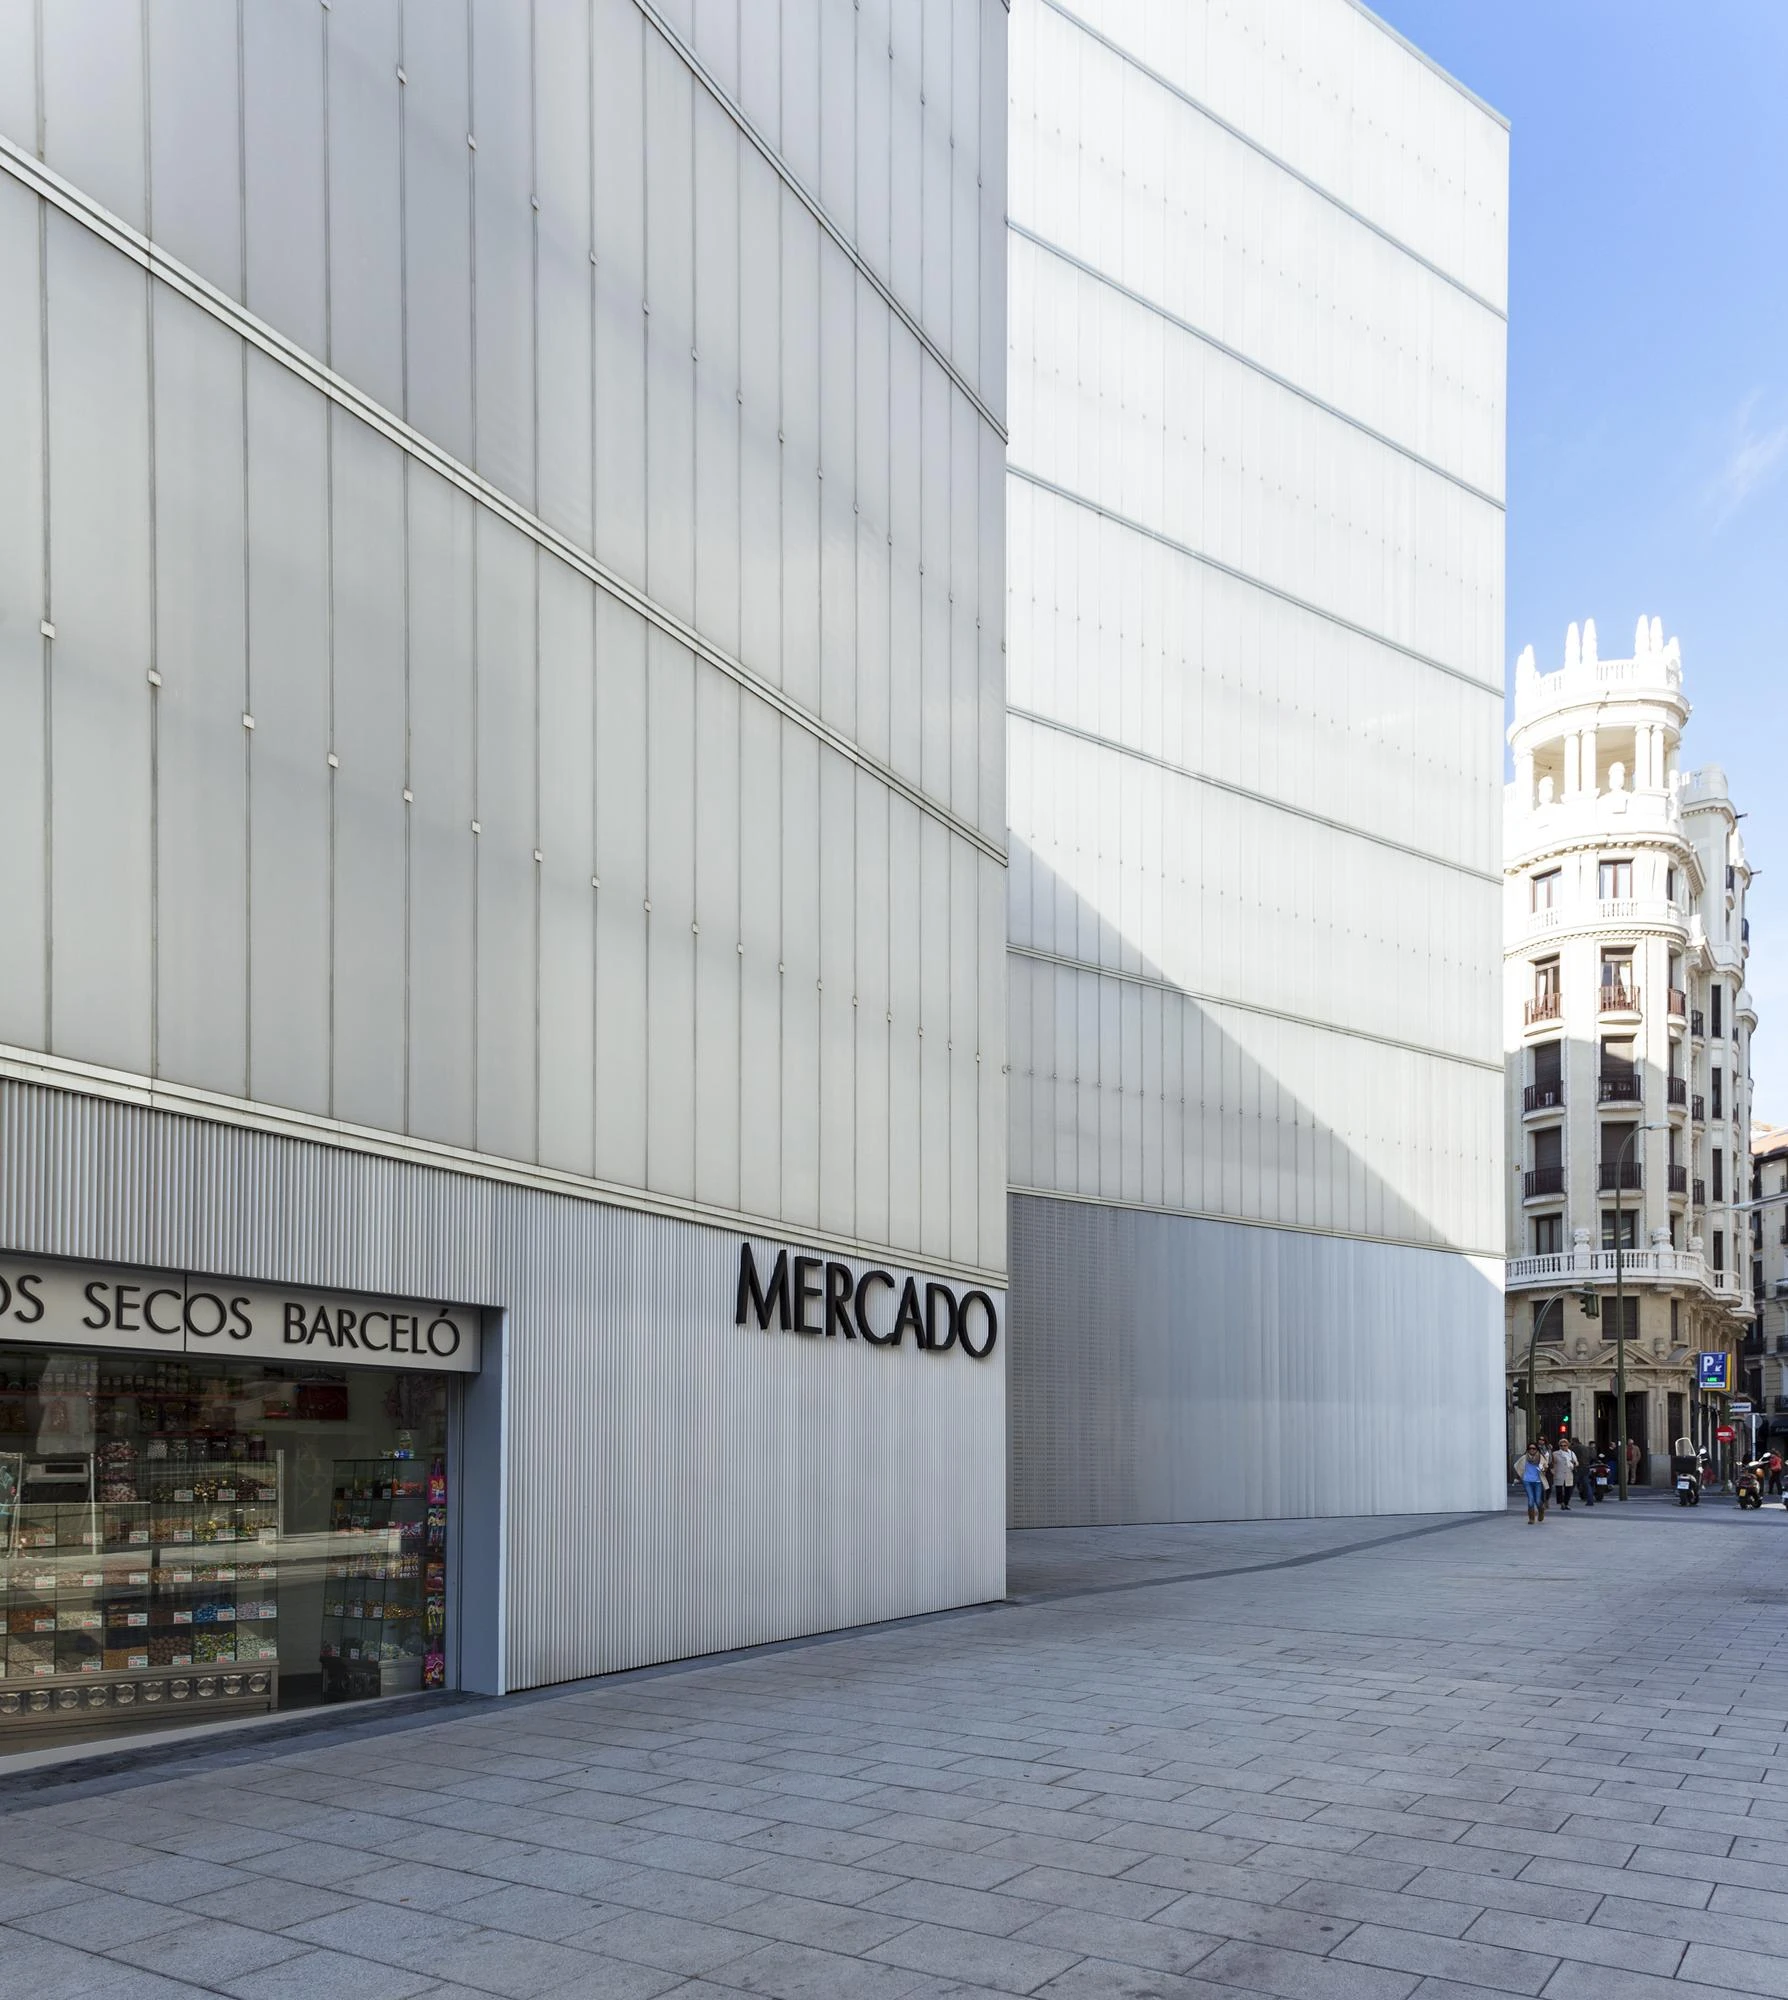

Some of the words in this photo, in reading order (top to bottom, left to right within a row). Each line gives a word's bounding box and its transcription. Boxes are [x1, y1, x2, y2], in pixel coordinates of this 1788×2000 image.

[0, 1273, 45, 1323] S
[83, 1281, 253, 1340] SECOS
[283, 1302, 461, 1357] BARCELÓ
[735, 1241, 997, 1358] MERCADO
[1703, 1355, 1714, 1372] P
